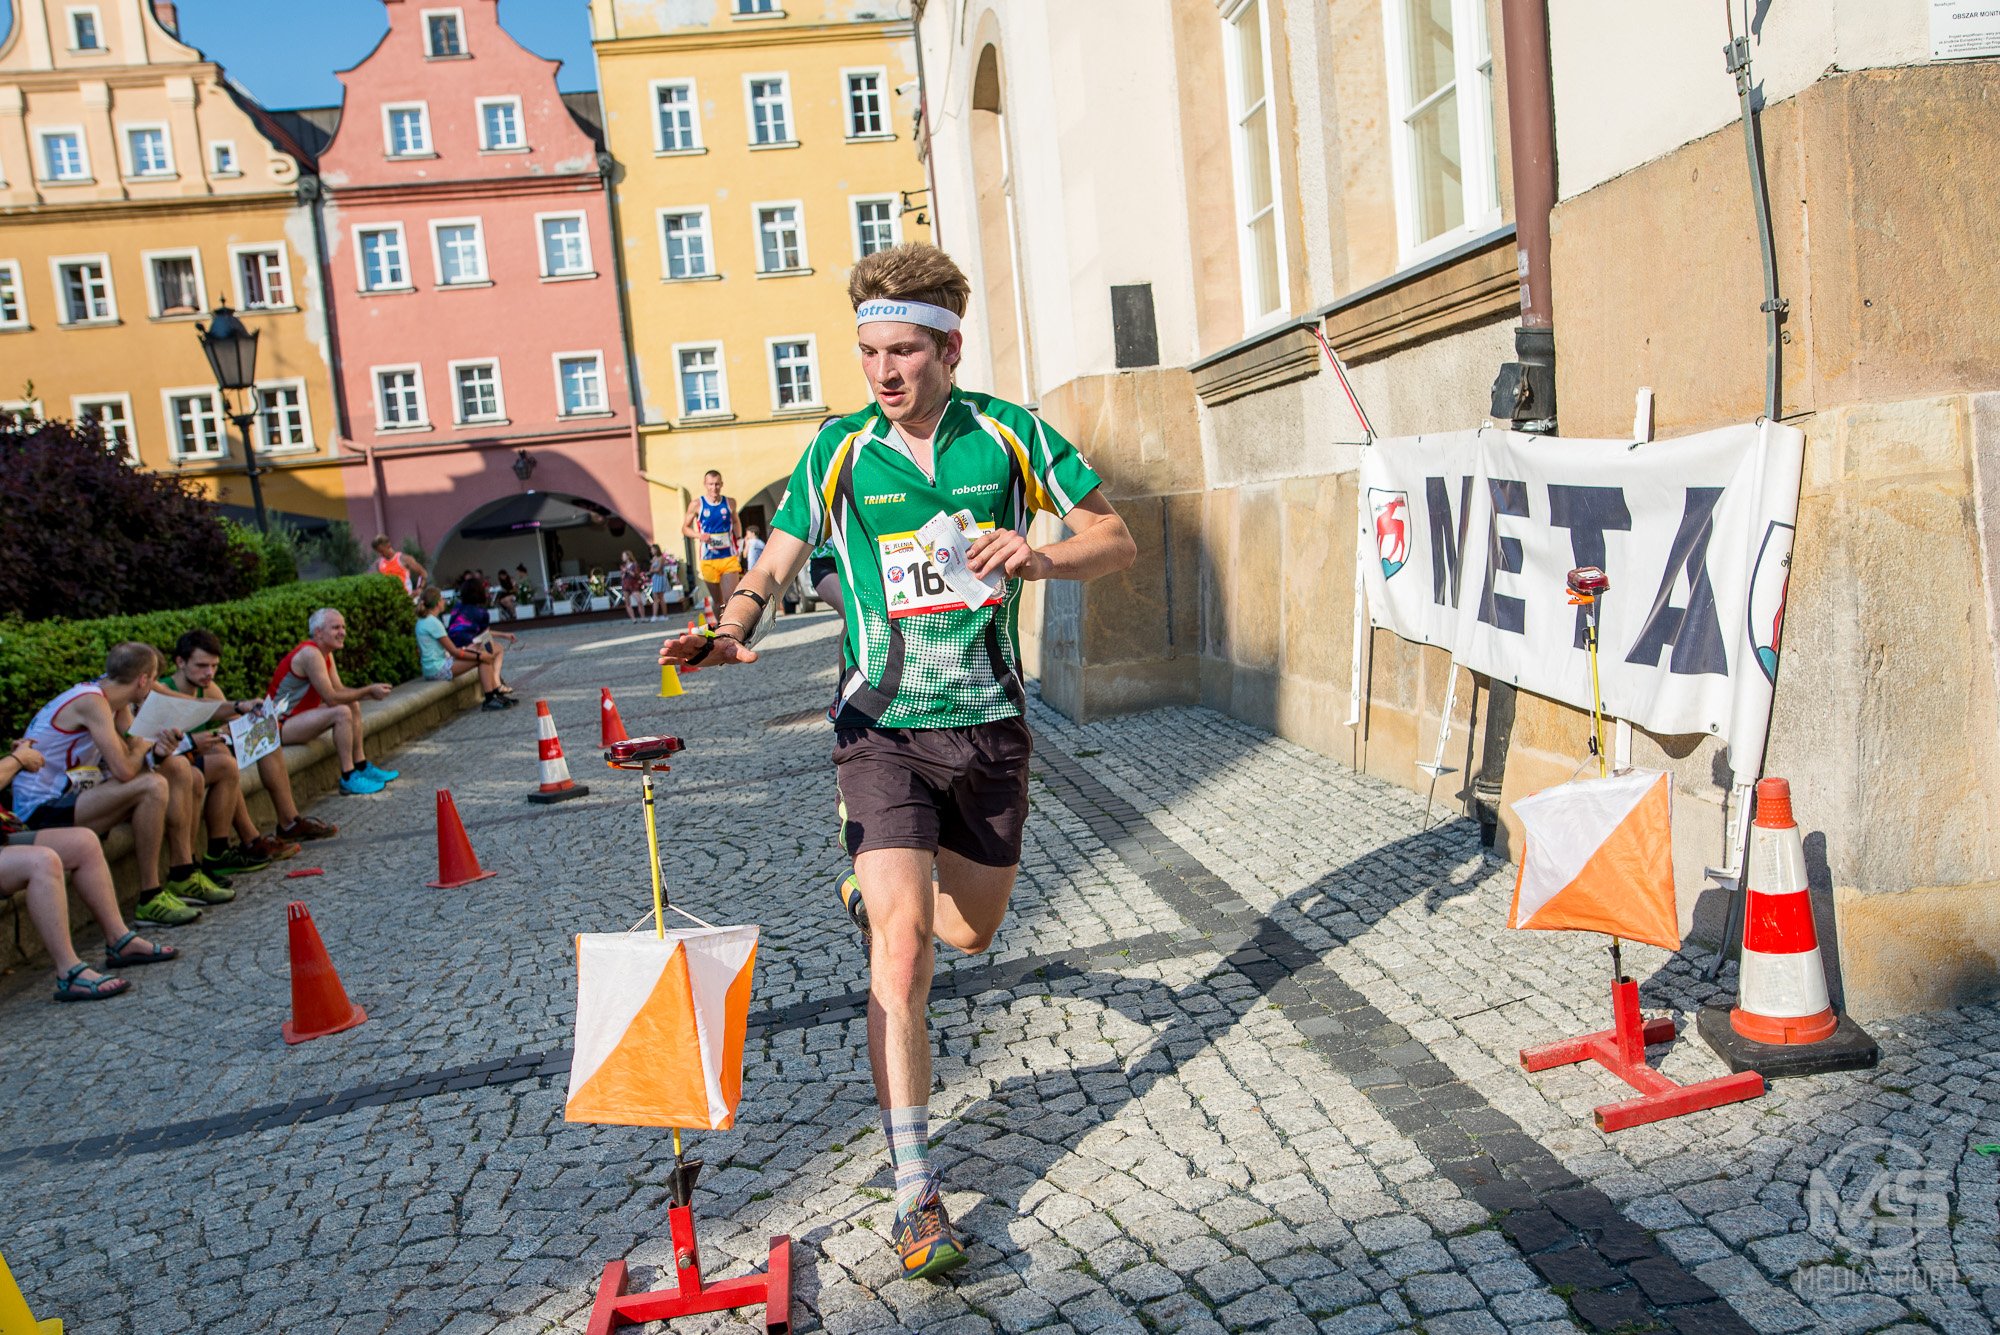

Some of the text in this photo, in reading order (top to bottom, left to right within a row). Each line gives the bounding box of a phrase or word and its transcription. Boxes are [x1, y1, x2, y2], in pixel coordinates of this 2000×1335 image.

[1952, 12, 1979, 20] OBSZAR
[952, 483, 999, 495] robotron
[864, 493, 906, 505] TRIMTEX
[907, 561, 954, 597] 16
[1425, 476, 1728, 676] META
